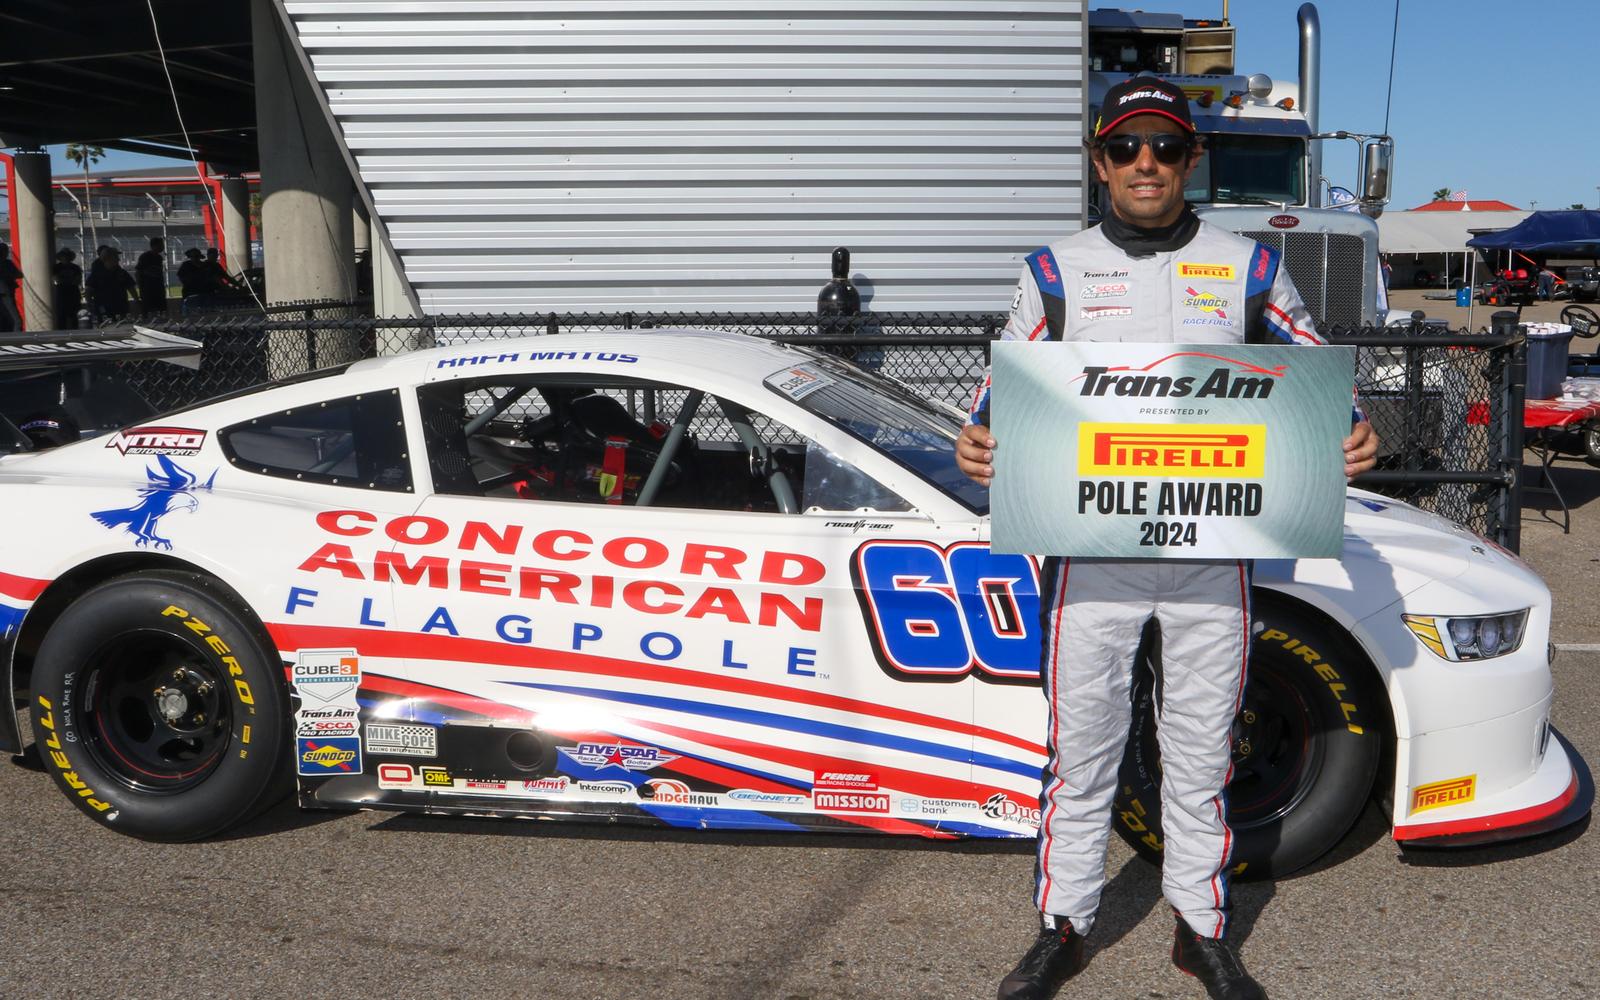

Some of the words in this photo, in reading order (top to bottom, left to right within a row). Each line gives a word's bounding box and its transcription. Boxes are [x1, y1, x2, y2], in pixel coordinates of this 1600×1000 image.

[1119, 91, 1152, 105] Trans
[1152, 90, 1173, 103] Am
[1183, 265, 1229, 277] PIRELLI
[1186, 299, 1228, 307] SUNOCO
[1080, 366, 1193, 398] Trans
[1195, 368, 1275, 399] Am
[106, 432, 205, 454] NITRO
[1094, 433, 1249, 467] PIRELLI
[128, 448, 200, 456] MOTORSPORTS
[1078, 481, 1147, 515] POLE
[1157, 482, 1263, 517] AWARD
[1139, 522, 1198, 547] 2024
[315, 510, 827, 586] CONCORD
[297, 542, 824, 632] AMERICAN
[849, 539, 1041, 688] 60
[285, 587, 817, 677] FLAGPOLE
[295, 665, 352, 675] CUBE3
[1260, 628, 1363, 735] PIRELLI
[302, 710, 332, 718] Trans
[334, 709, 354, 717] Am
[368, 728, 400, 740] MIKE
[402, 735, 434, 747] COPE
[39, 696, 114, 812] PIRELLI
[305, 752, 353, 761] SUNOCO
[578, 744, 614, 755] FIVE
[620, 747, 658, 760] STAR
[821, 772, 870, 782] PENSKE
[580, 783, 627, 794] Intercomp
[1413, 778, 1473, 809] PIRELLI
[653, 793, 719, 806] RIDGEHAUL
[736, 791, 803, 802] BENNETT
[922, 799, 977, 809] customers
[922, 806, 948, 814] bank
